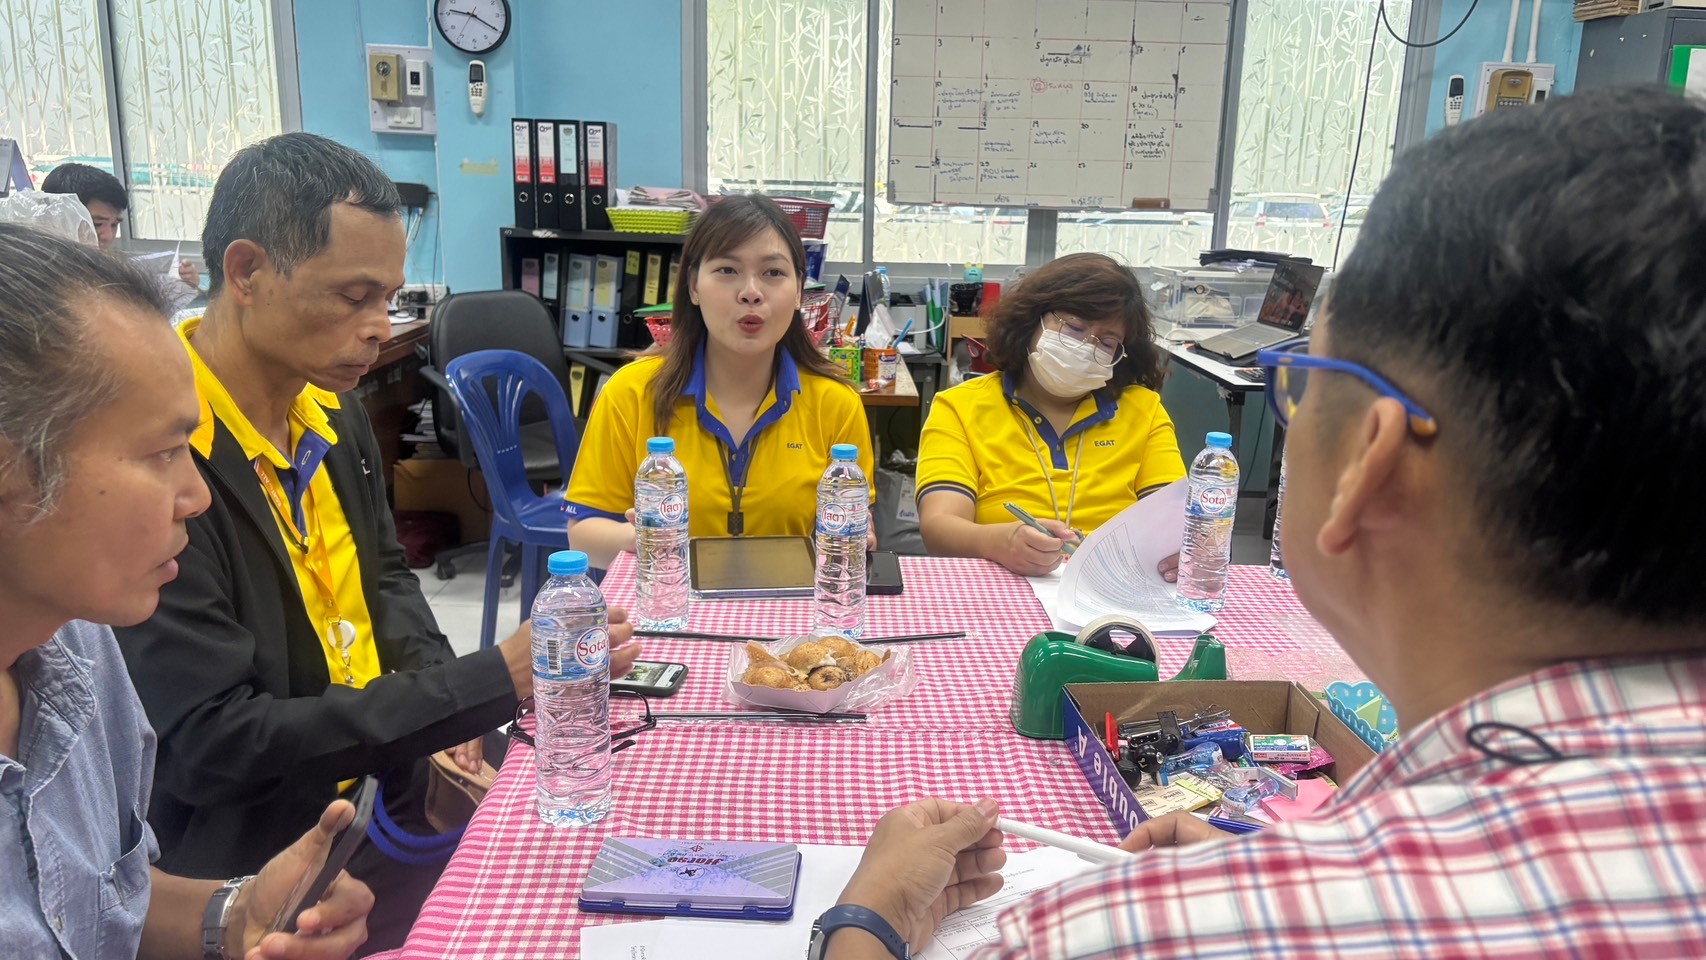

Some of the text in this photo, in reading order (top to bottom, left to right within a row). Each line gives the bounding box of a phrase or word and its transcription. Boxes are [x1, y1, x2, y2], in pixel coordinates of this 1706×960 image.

[1094, 439, 1115, 447] EGAT
[1201, 493, 1226, 505] Sota
[566, 504, 577, 515] ALL
[823, 508, 845, 521] โสตา
[1093, 751, 1140, 831] ouble
[667, 857, 724, 866] Horse
